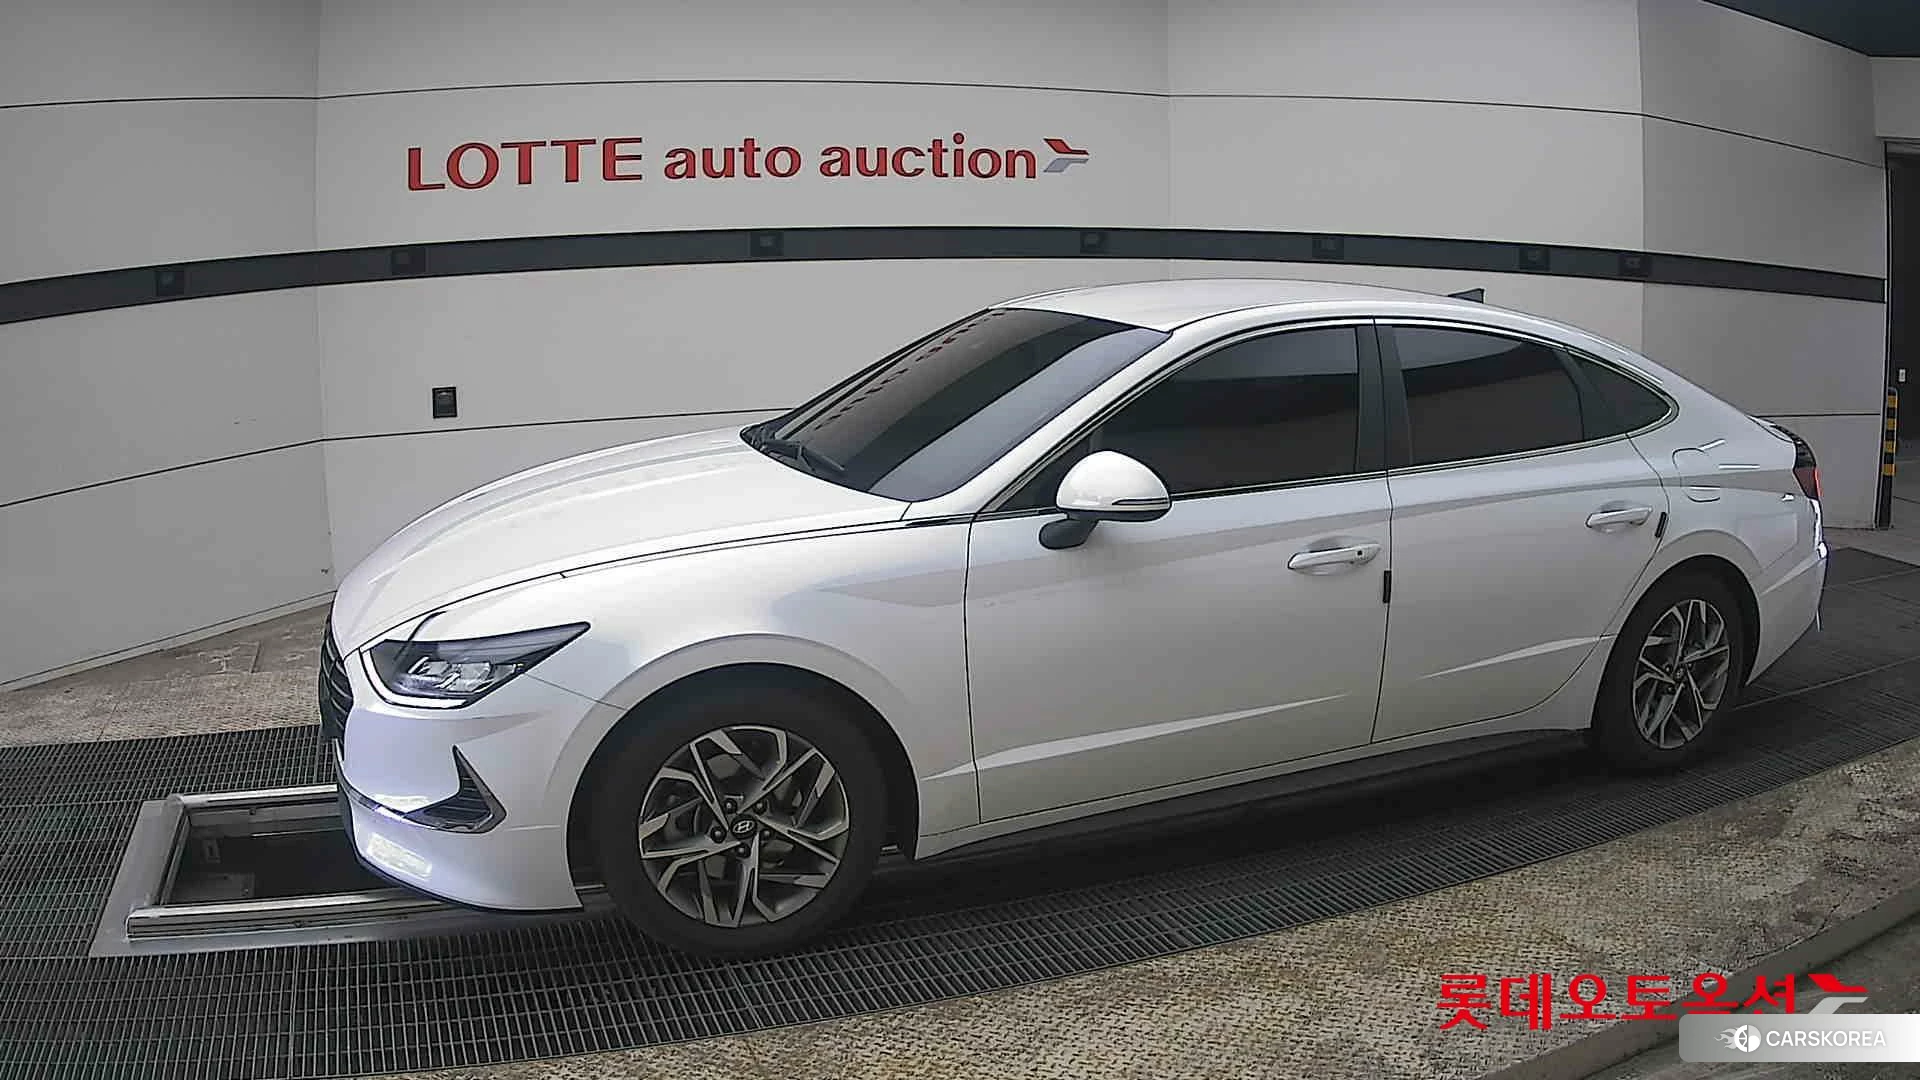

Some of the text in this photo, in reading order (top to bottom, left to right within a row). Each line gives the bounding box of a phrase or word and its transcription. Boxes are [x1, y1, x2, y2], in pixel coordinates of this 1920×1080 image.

[407, 132, 1037, 191] LOTTE auto auction
